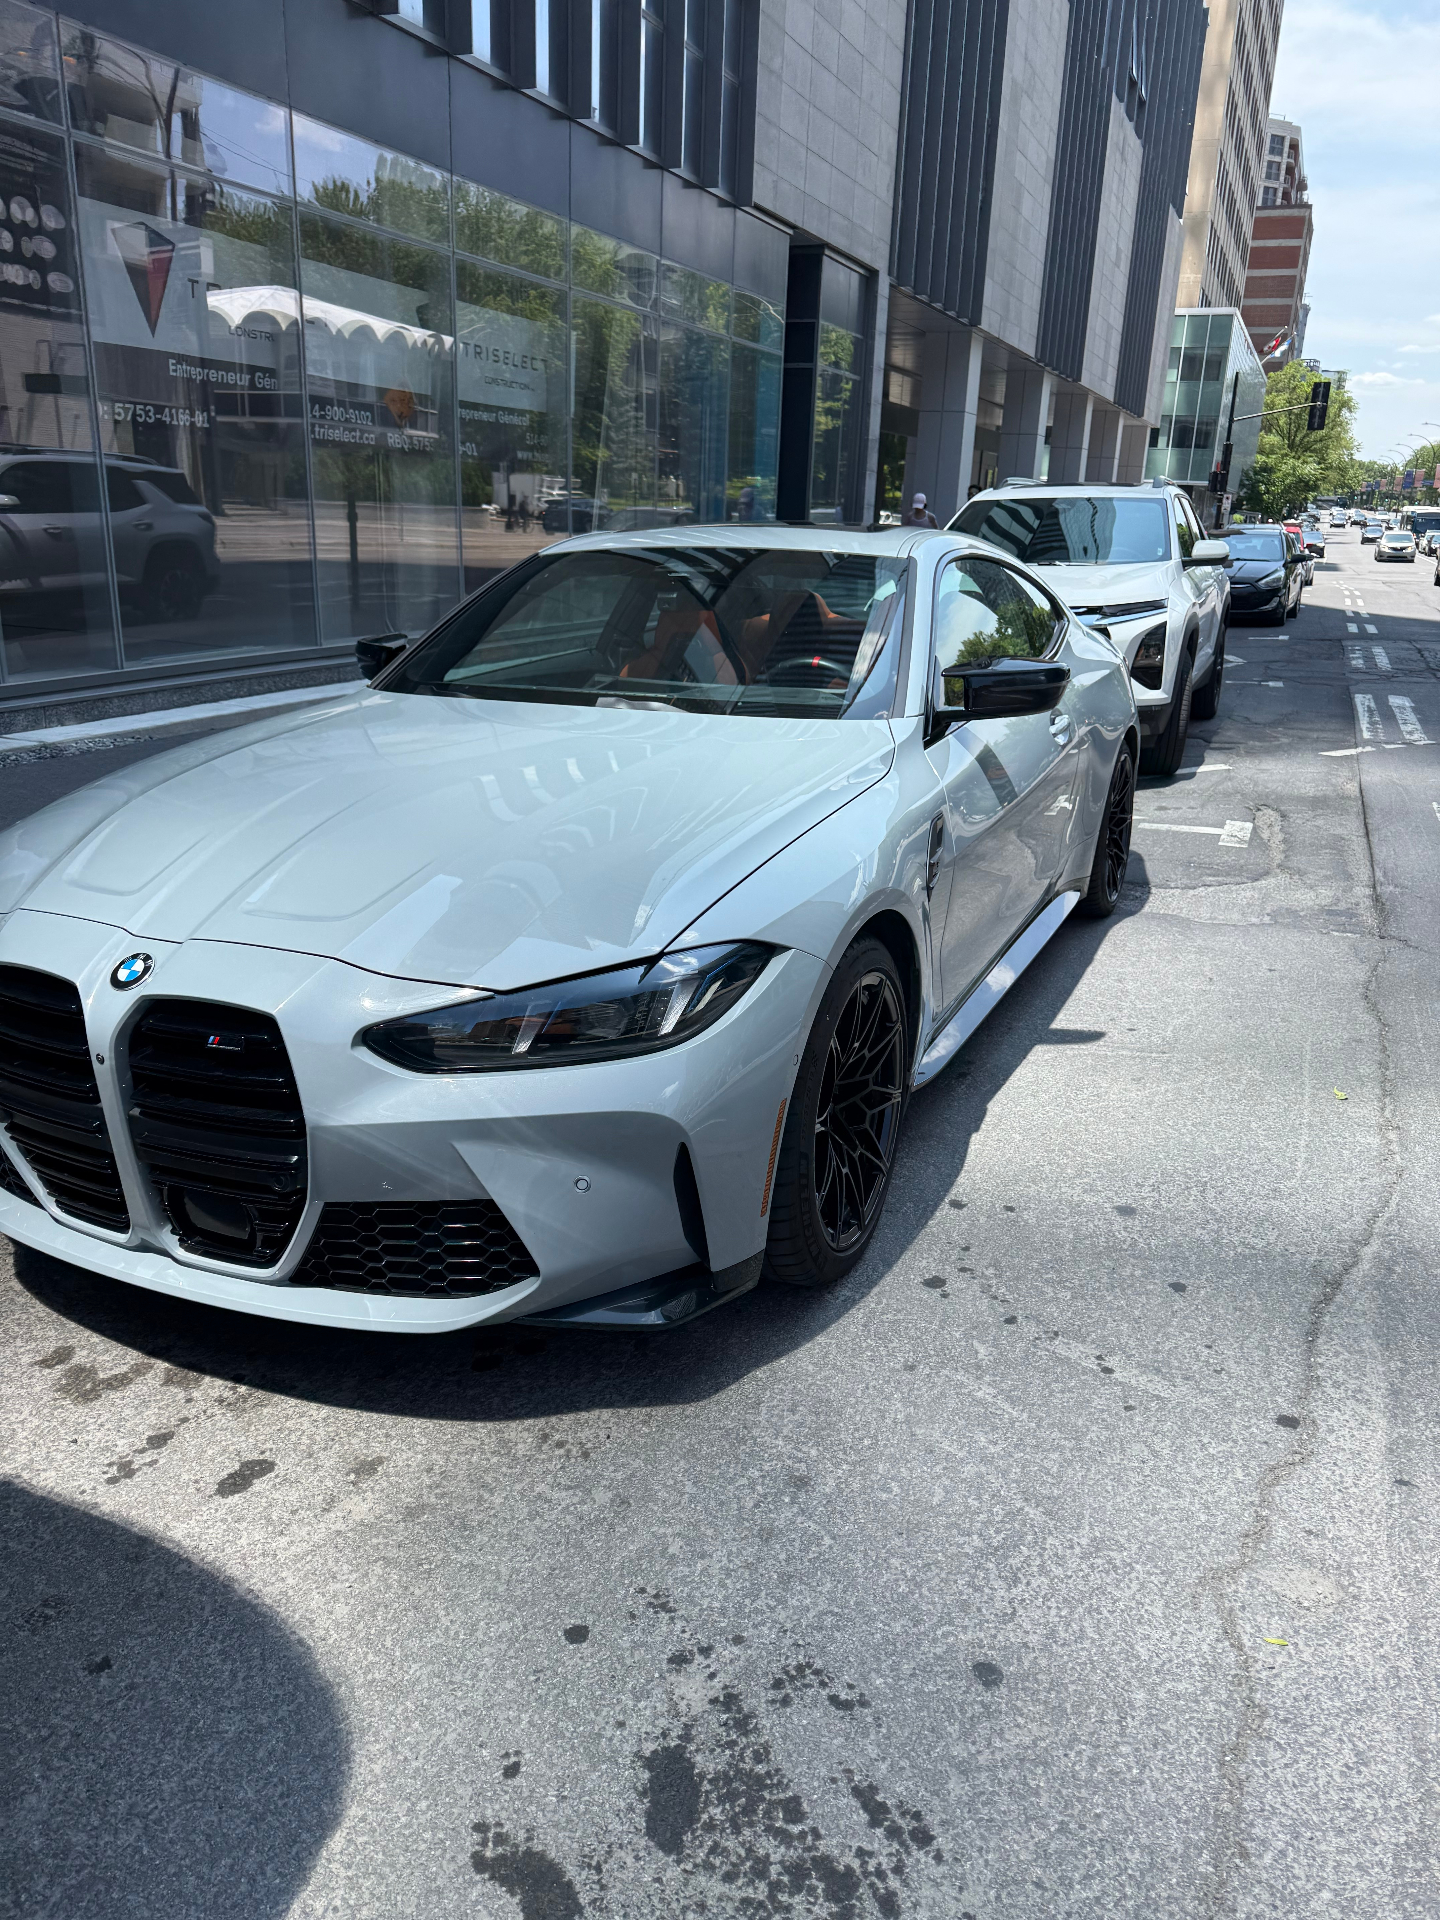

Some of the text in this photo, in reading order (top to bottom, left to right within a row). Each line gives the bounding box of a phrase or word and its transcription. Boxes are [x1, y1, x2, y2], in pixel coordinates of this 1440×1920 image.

[461, 341, 549, 374] TRISELECT
[168, 358, 251, 386] Entrepreneur
[113, 402, 210, 428] 5753-4166-01
[309, 403, 373, 426] 4-900-9102
[497, 410, 530, 426] Général
[387, 433, 412, 451] RBQ:
[799, 1158, 820, 1258] MICHELIN
